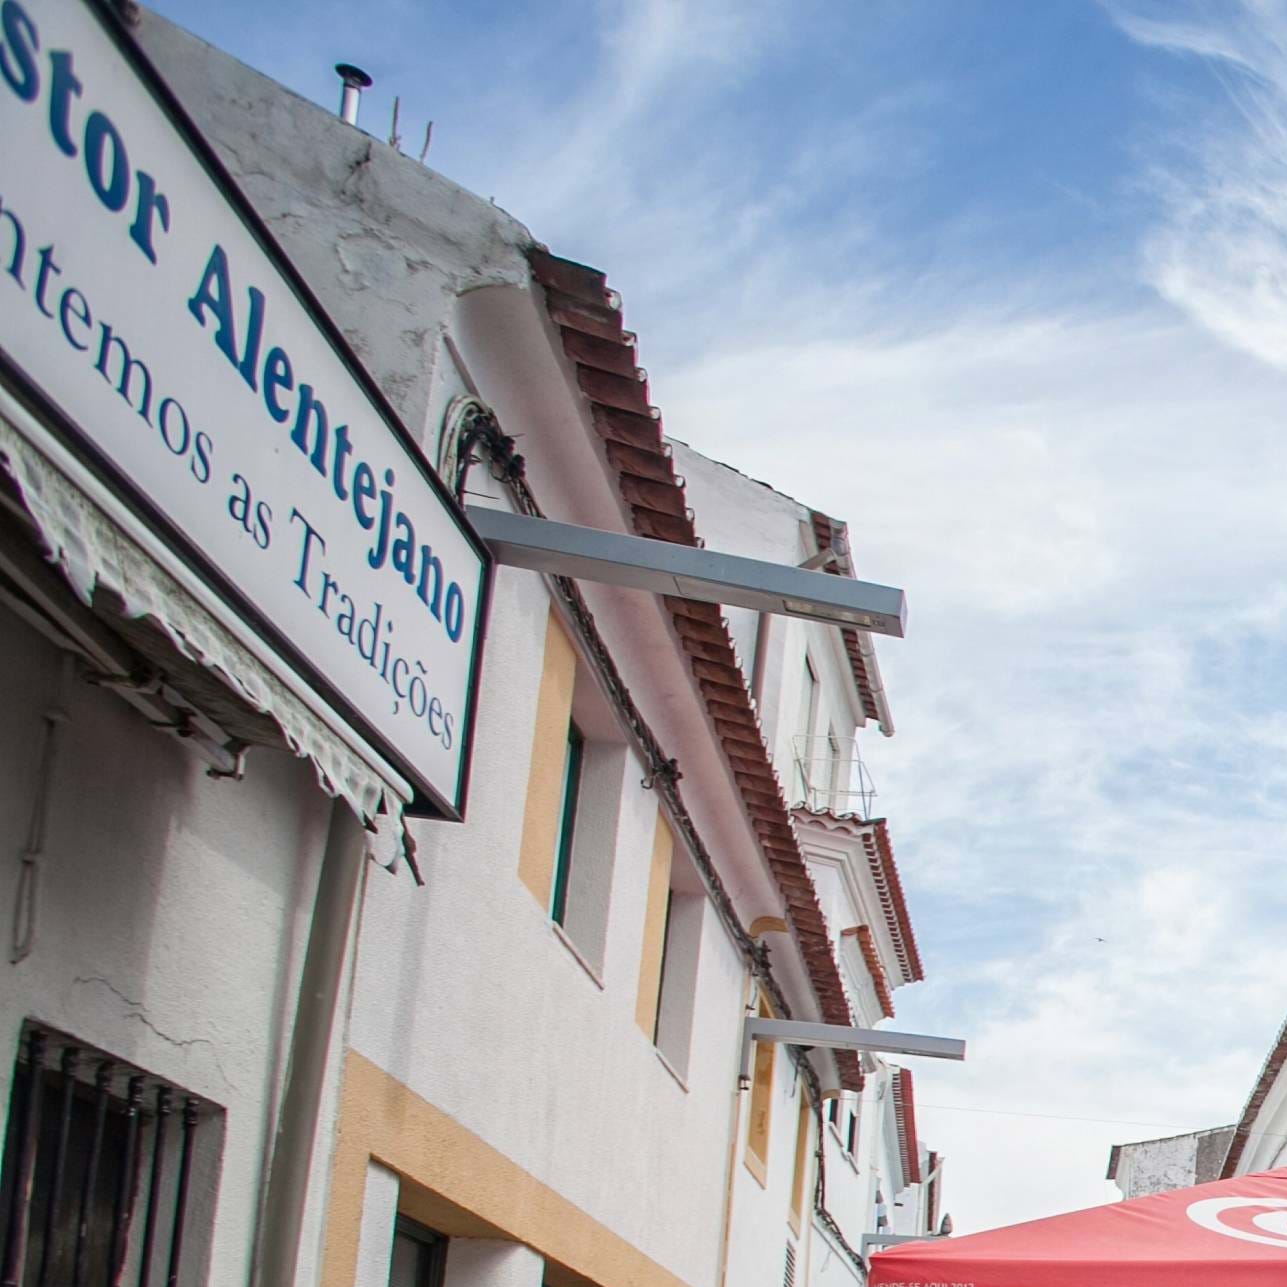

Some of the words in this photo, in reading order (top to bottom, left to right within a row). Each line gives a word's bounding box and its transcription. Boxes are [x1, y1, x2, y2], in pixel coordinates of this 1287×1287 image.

[188, 244, 466, 644] Alentejano
[228, 472, 273, 551] as
[290, 506, 456, 752] Tradições
